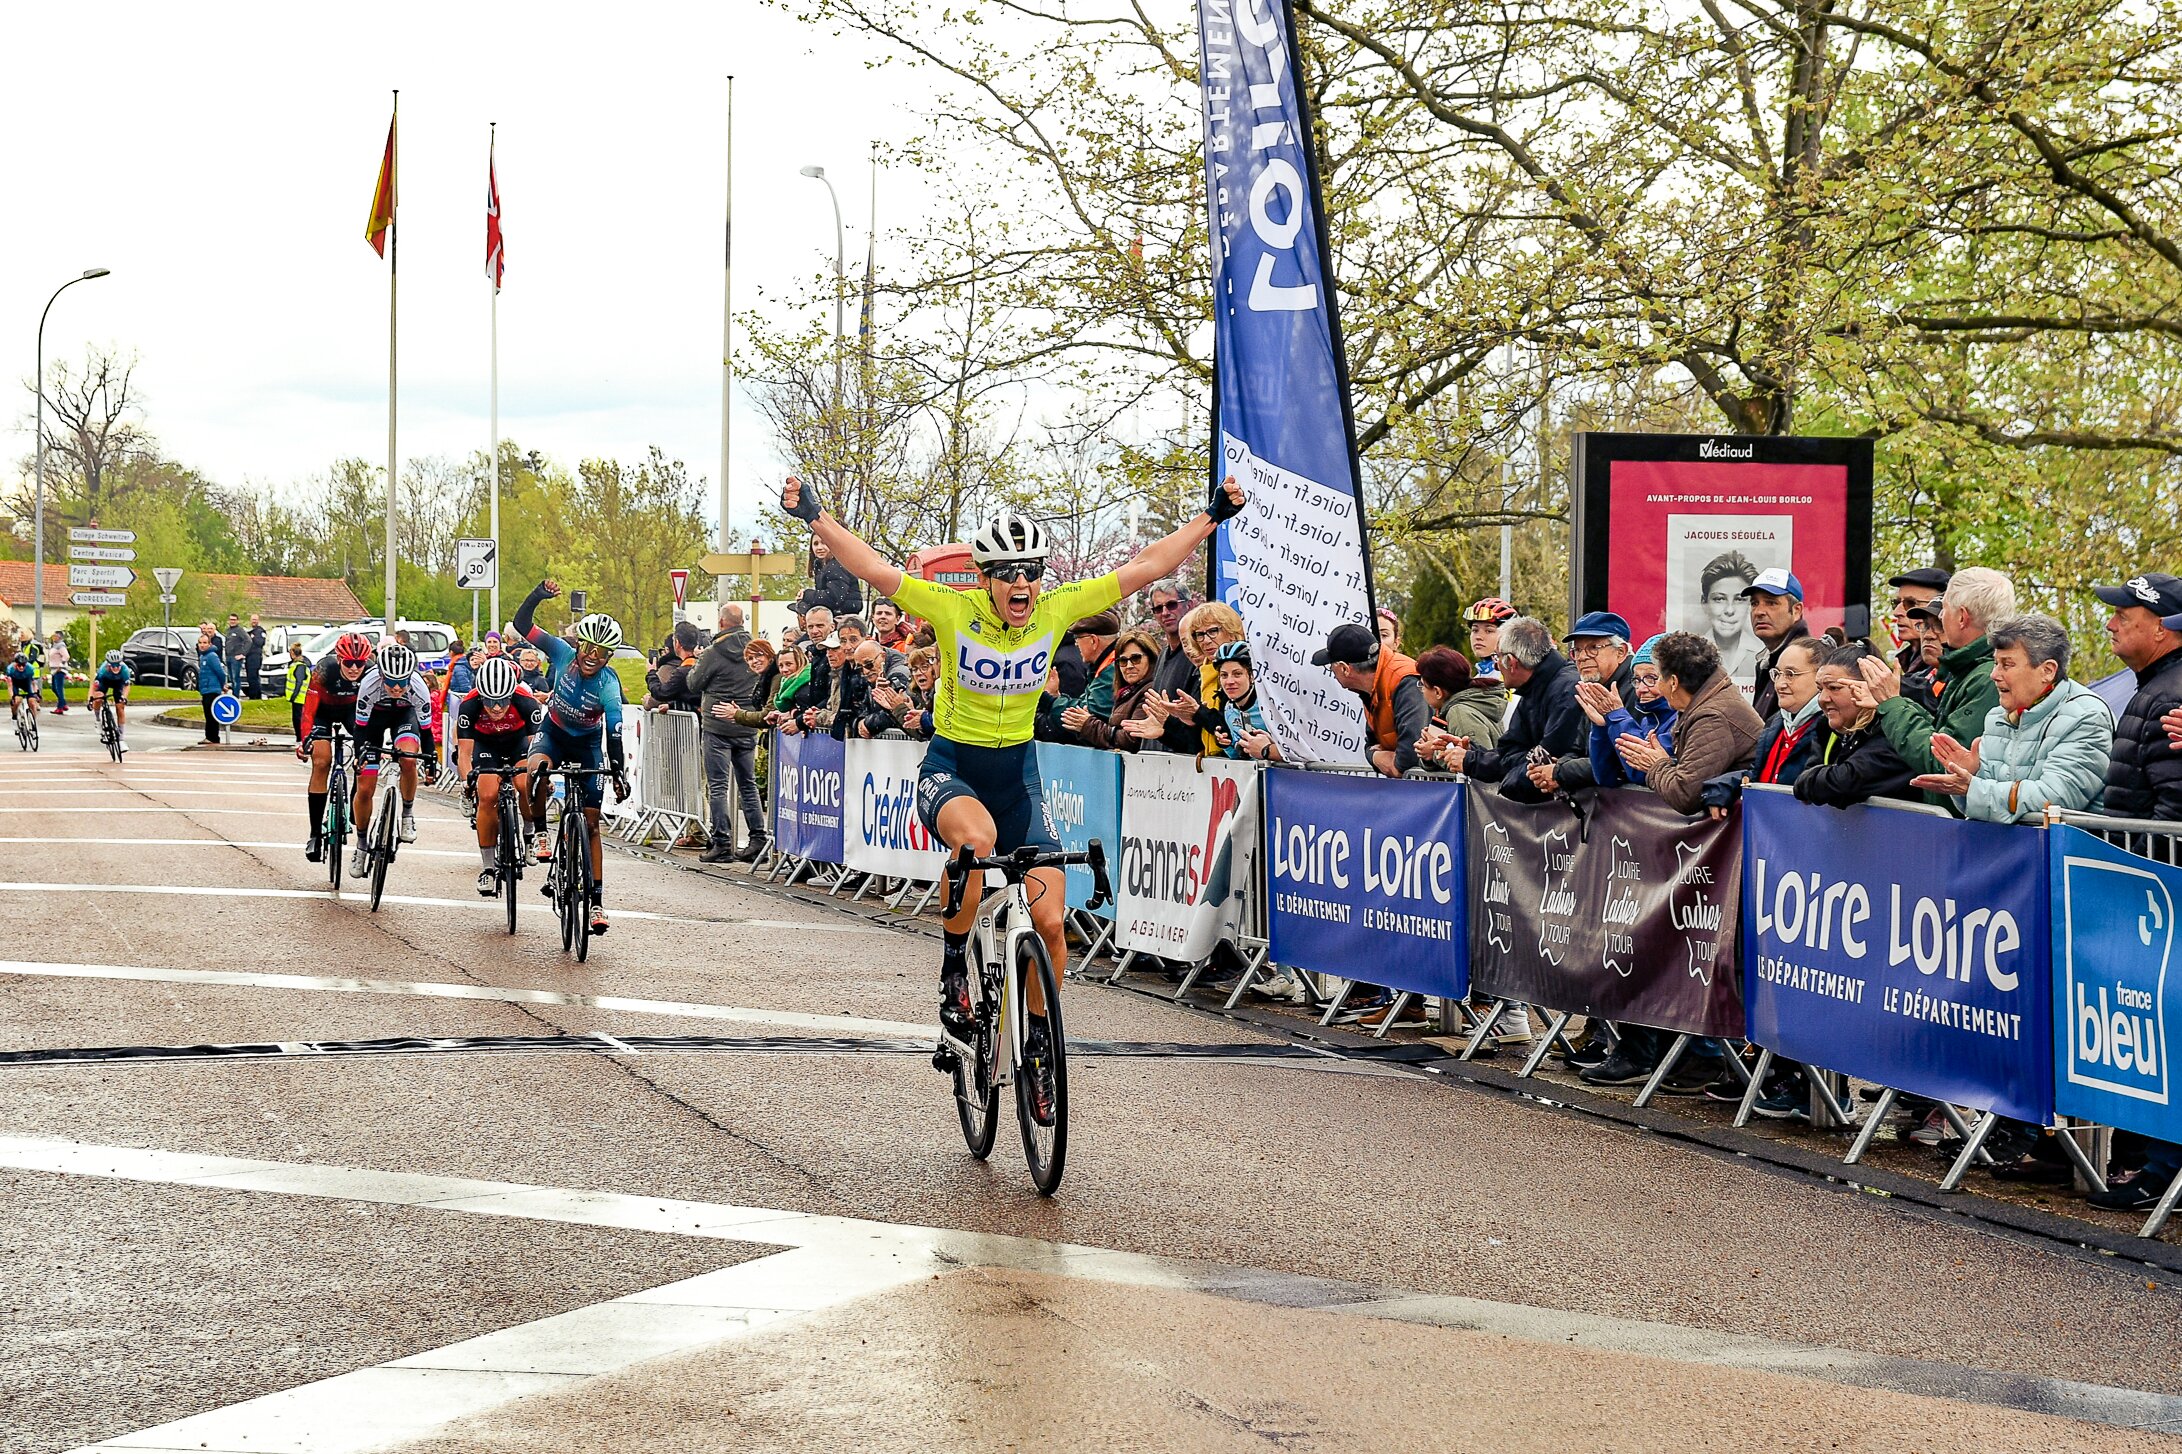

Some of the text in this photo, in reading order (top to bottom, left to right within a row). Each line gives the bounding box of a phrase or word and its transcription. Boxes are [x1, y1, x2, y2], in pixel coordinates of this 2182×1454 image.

[1646, 494, 1813, 504] AVANT-PROPOS DE JEAN-LOUIS BORLOO
[1684, 529, 1775, 541] JACQUES SÉGUÉLA
[73, 549, 95, 557] Centre
[469, 564, 484, 574] 30
[959, 645, 1048, 680] Loire
[802, 765, 841, 807] Loire
[862, 771, 914, 850] Crédit
[1051, 779, 1084, 832] Région
[1274, 816, 1452, 904] Loire Loire
[1489, 844, 1515, 864] LOIRE
[1552, 853, 1576, 873] LOIRE
[1618, 860, 1641, 881] LOIRE
[1680, 866, 1715, 884] LOIRE
[1540, 873, 1576, 916] Ladies
[1602, 880, 1641, 925] Ladies
[1669, 887, 1722, 931] Ladies
[1276, 891, 1452, 941] LE DÉPARTEMENT LE DÉPARTEMENT
[1755, 858, 2020, 992] Loire Loire
[1549, 924, 1571, 945] TOUR
[1610, 933, 1633, 955] TOUR
[1757, 954, 2021, 1041] LE DÉPARTEMENT LE DÉPARTEMENT
[2116, 980, 2152, 1010] france
[2077, 982, 2157, 1077] bleu
